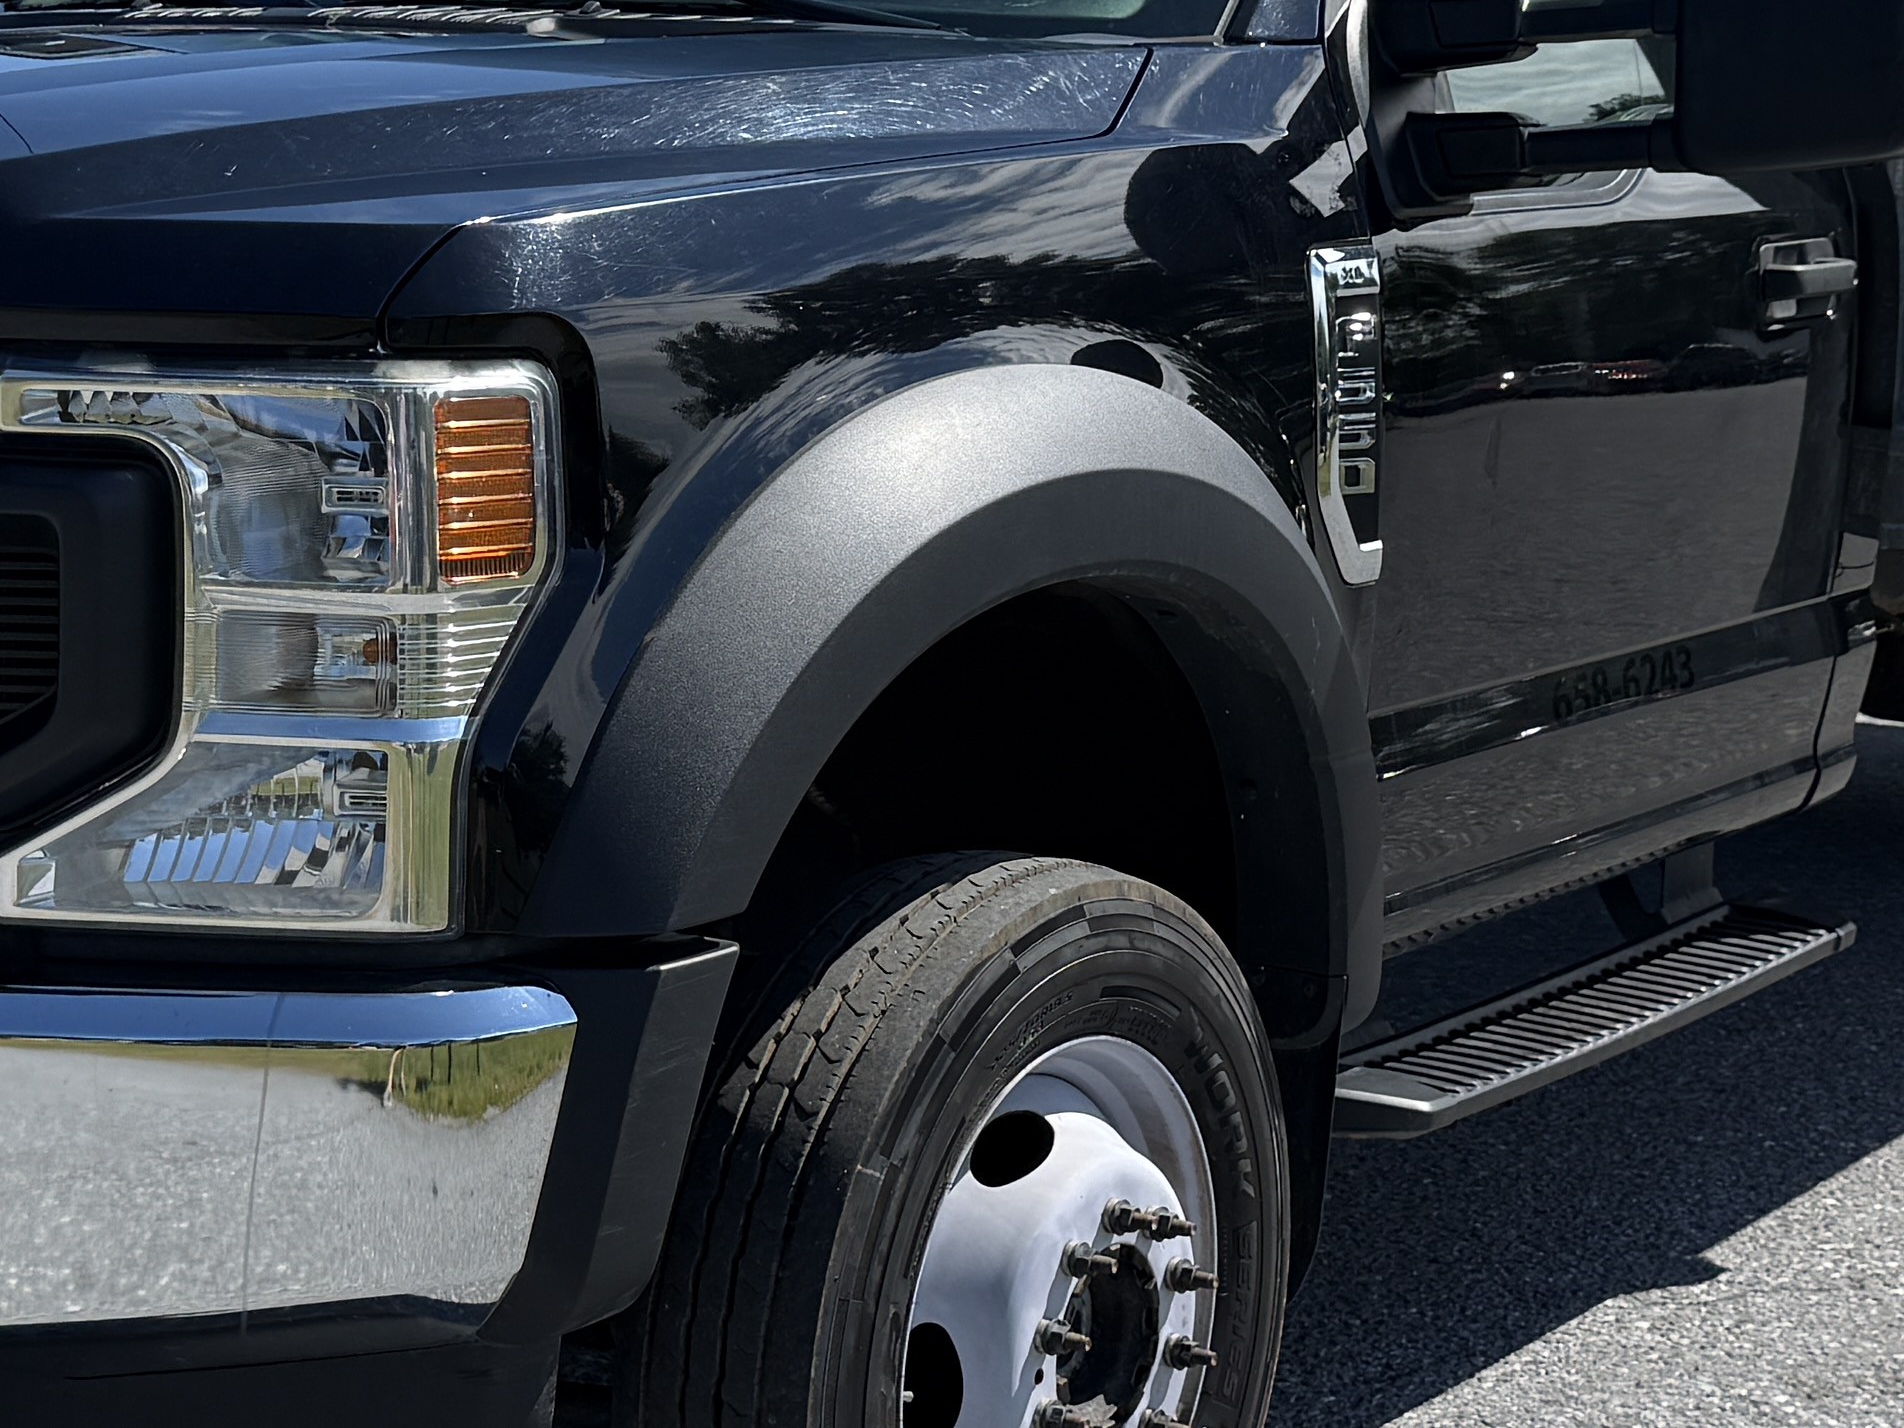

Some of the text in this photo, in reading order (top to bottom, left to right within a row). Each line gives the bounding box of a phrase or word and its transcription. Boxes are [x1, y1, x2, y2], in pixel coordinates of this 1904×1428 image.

[1339, 266, 1365, 285] XL
[1551, 644, 1696, 722] 658-6243
[1188, 1008, 1256, 1405] WORK SERIES
